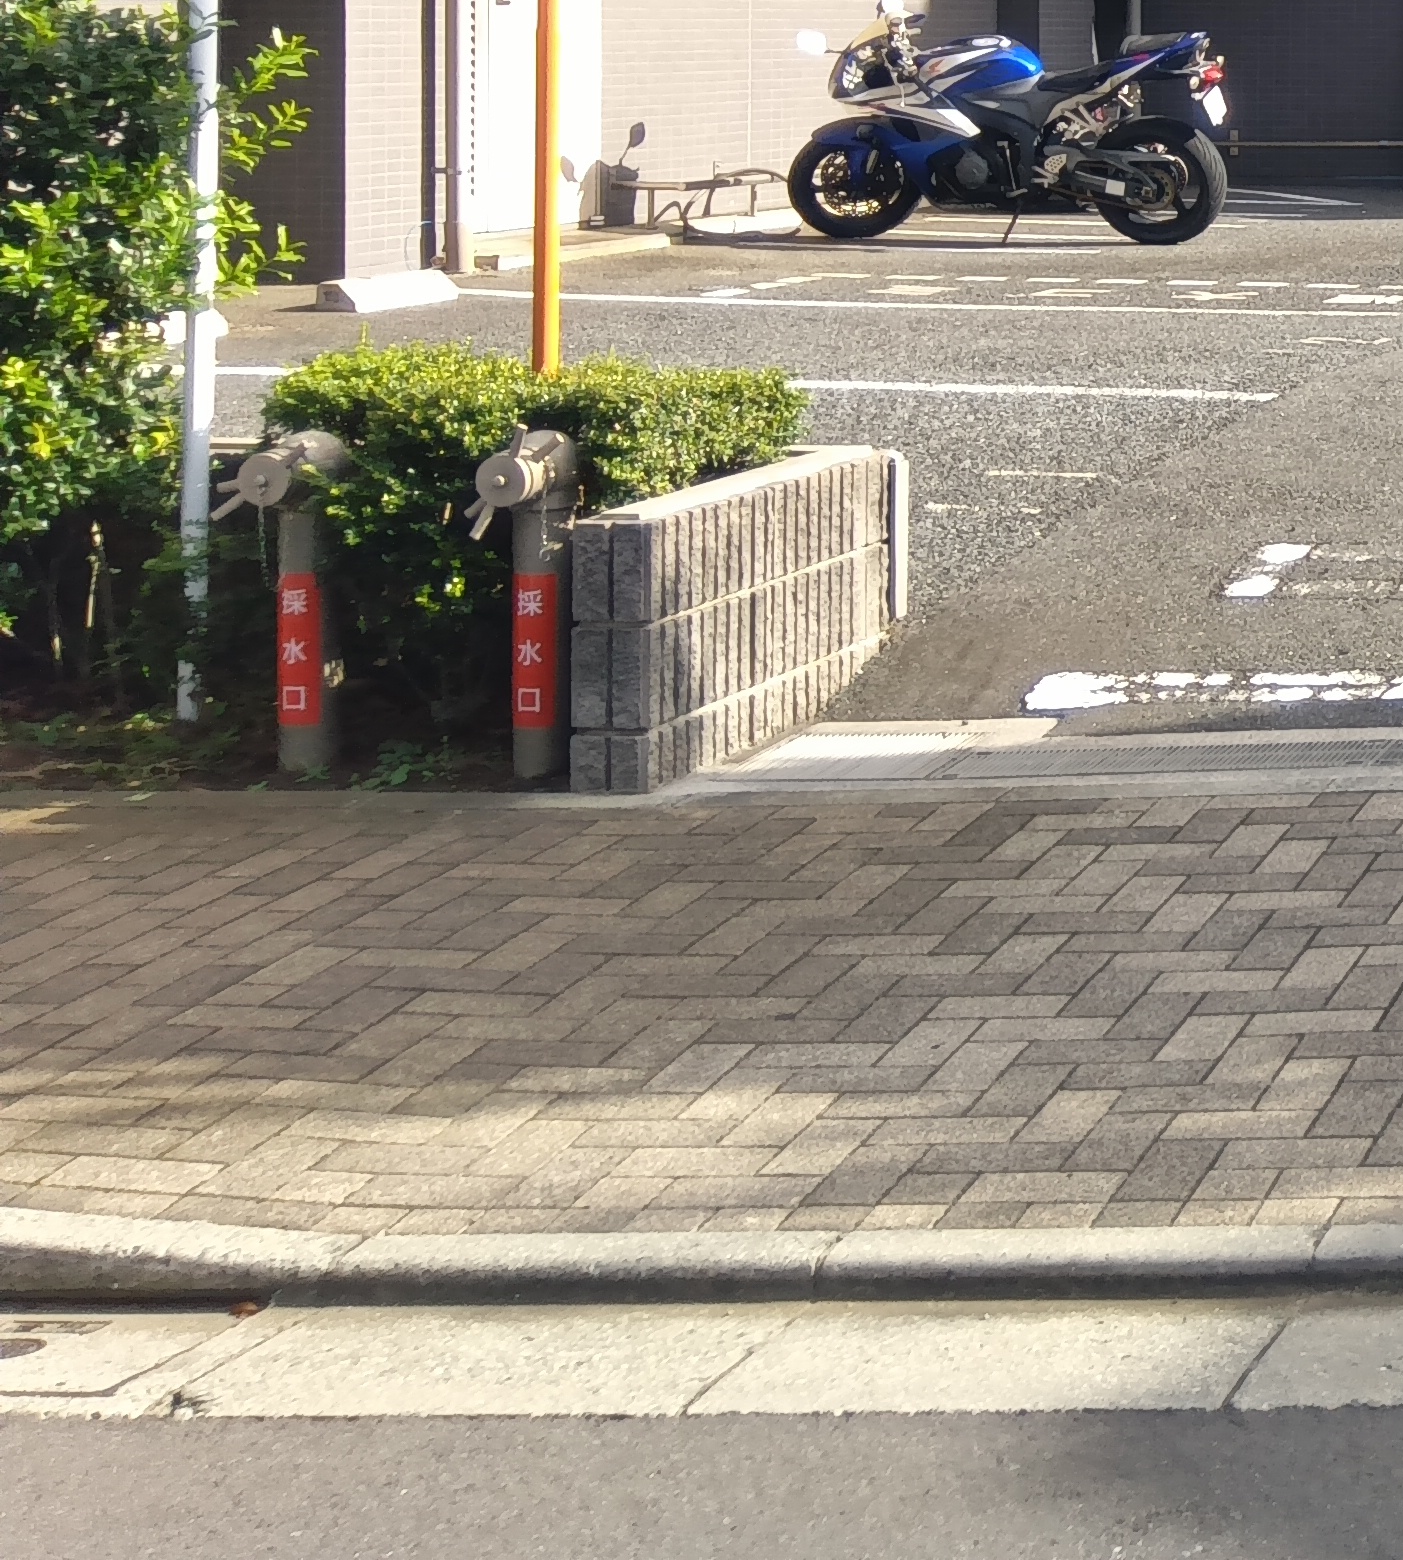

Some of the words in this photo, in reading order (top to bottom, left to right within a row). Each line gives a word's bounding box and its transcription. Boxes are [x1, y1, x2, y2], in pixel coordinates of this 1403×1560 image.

[282, 589, 308, 711] 採水口
[517, 590, 543, 712] 採水口
